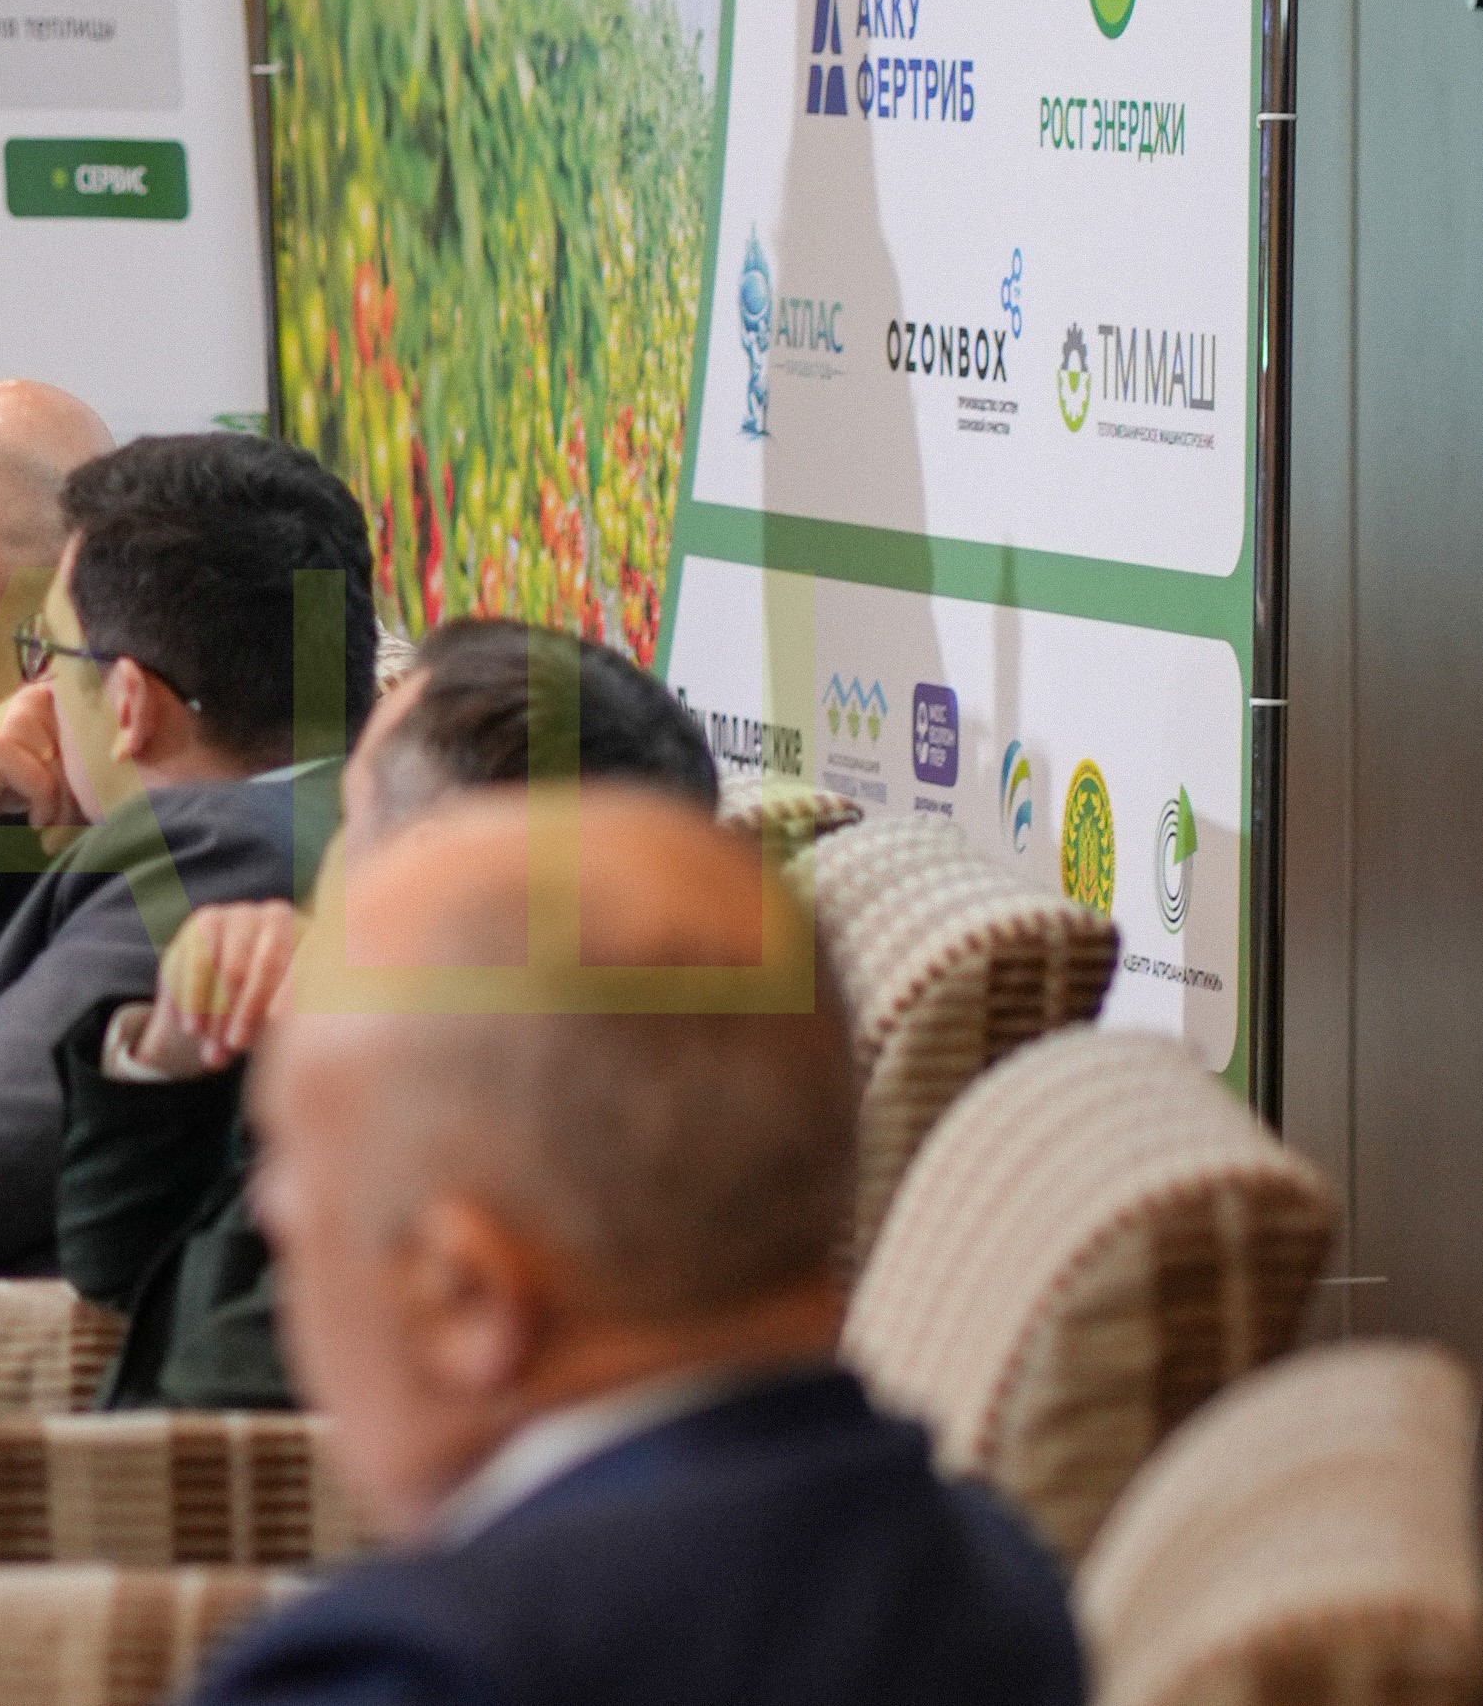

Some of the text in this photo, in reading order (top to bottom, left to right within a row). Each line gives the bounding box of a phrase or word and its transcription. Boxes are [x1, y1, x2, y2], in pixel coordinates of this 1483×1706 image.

[857, 53, 975, 122] ФЕРТРИБ
[1041, 97, 1186, 163] РОСТ ЭНЕРДЖИ
[75, 164, 147, 194] СЕРВИС
[777, 297, 845, 354] АТЛАС
[888, 319, 1007, 383] OZONBOX
[1099, 324, 1215, 411] ТМ МАШ
